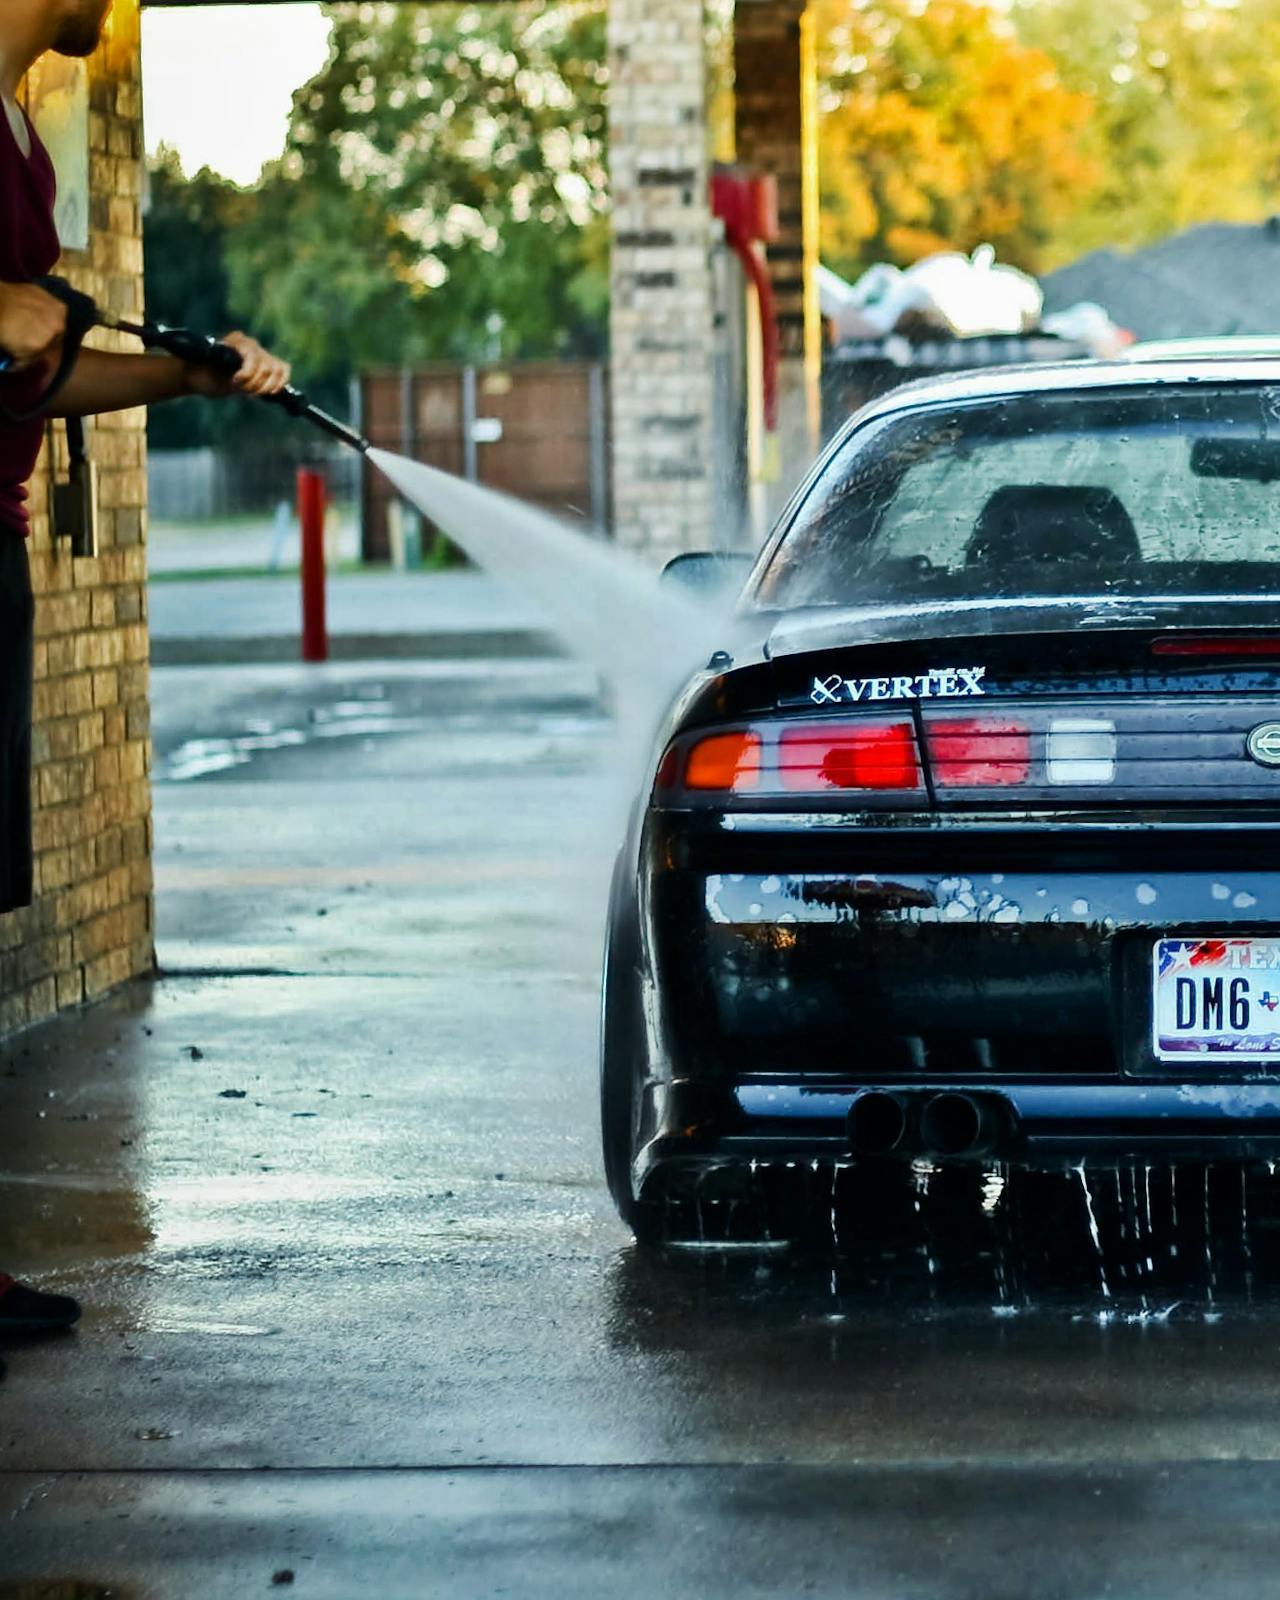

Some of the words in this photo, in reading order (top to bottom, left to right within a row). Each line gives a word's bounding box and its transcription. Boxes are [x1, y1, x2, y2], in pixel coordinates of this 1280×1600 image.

[844, 673, 985, 702] VERTEX
[1176, 977, 1250, 1031] DM6
[1233, 1037, 1267, 1051] Lone
